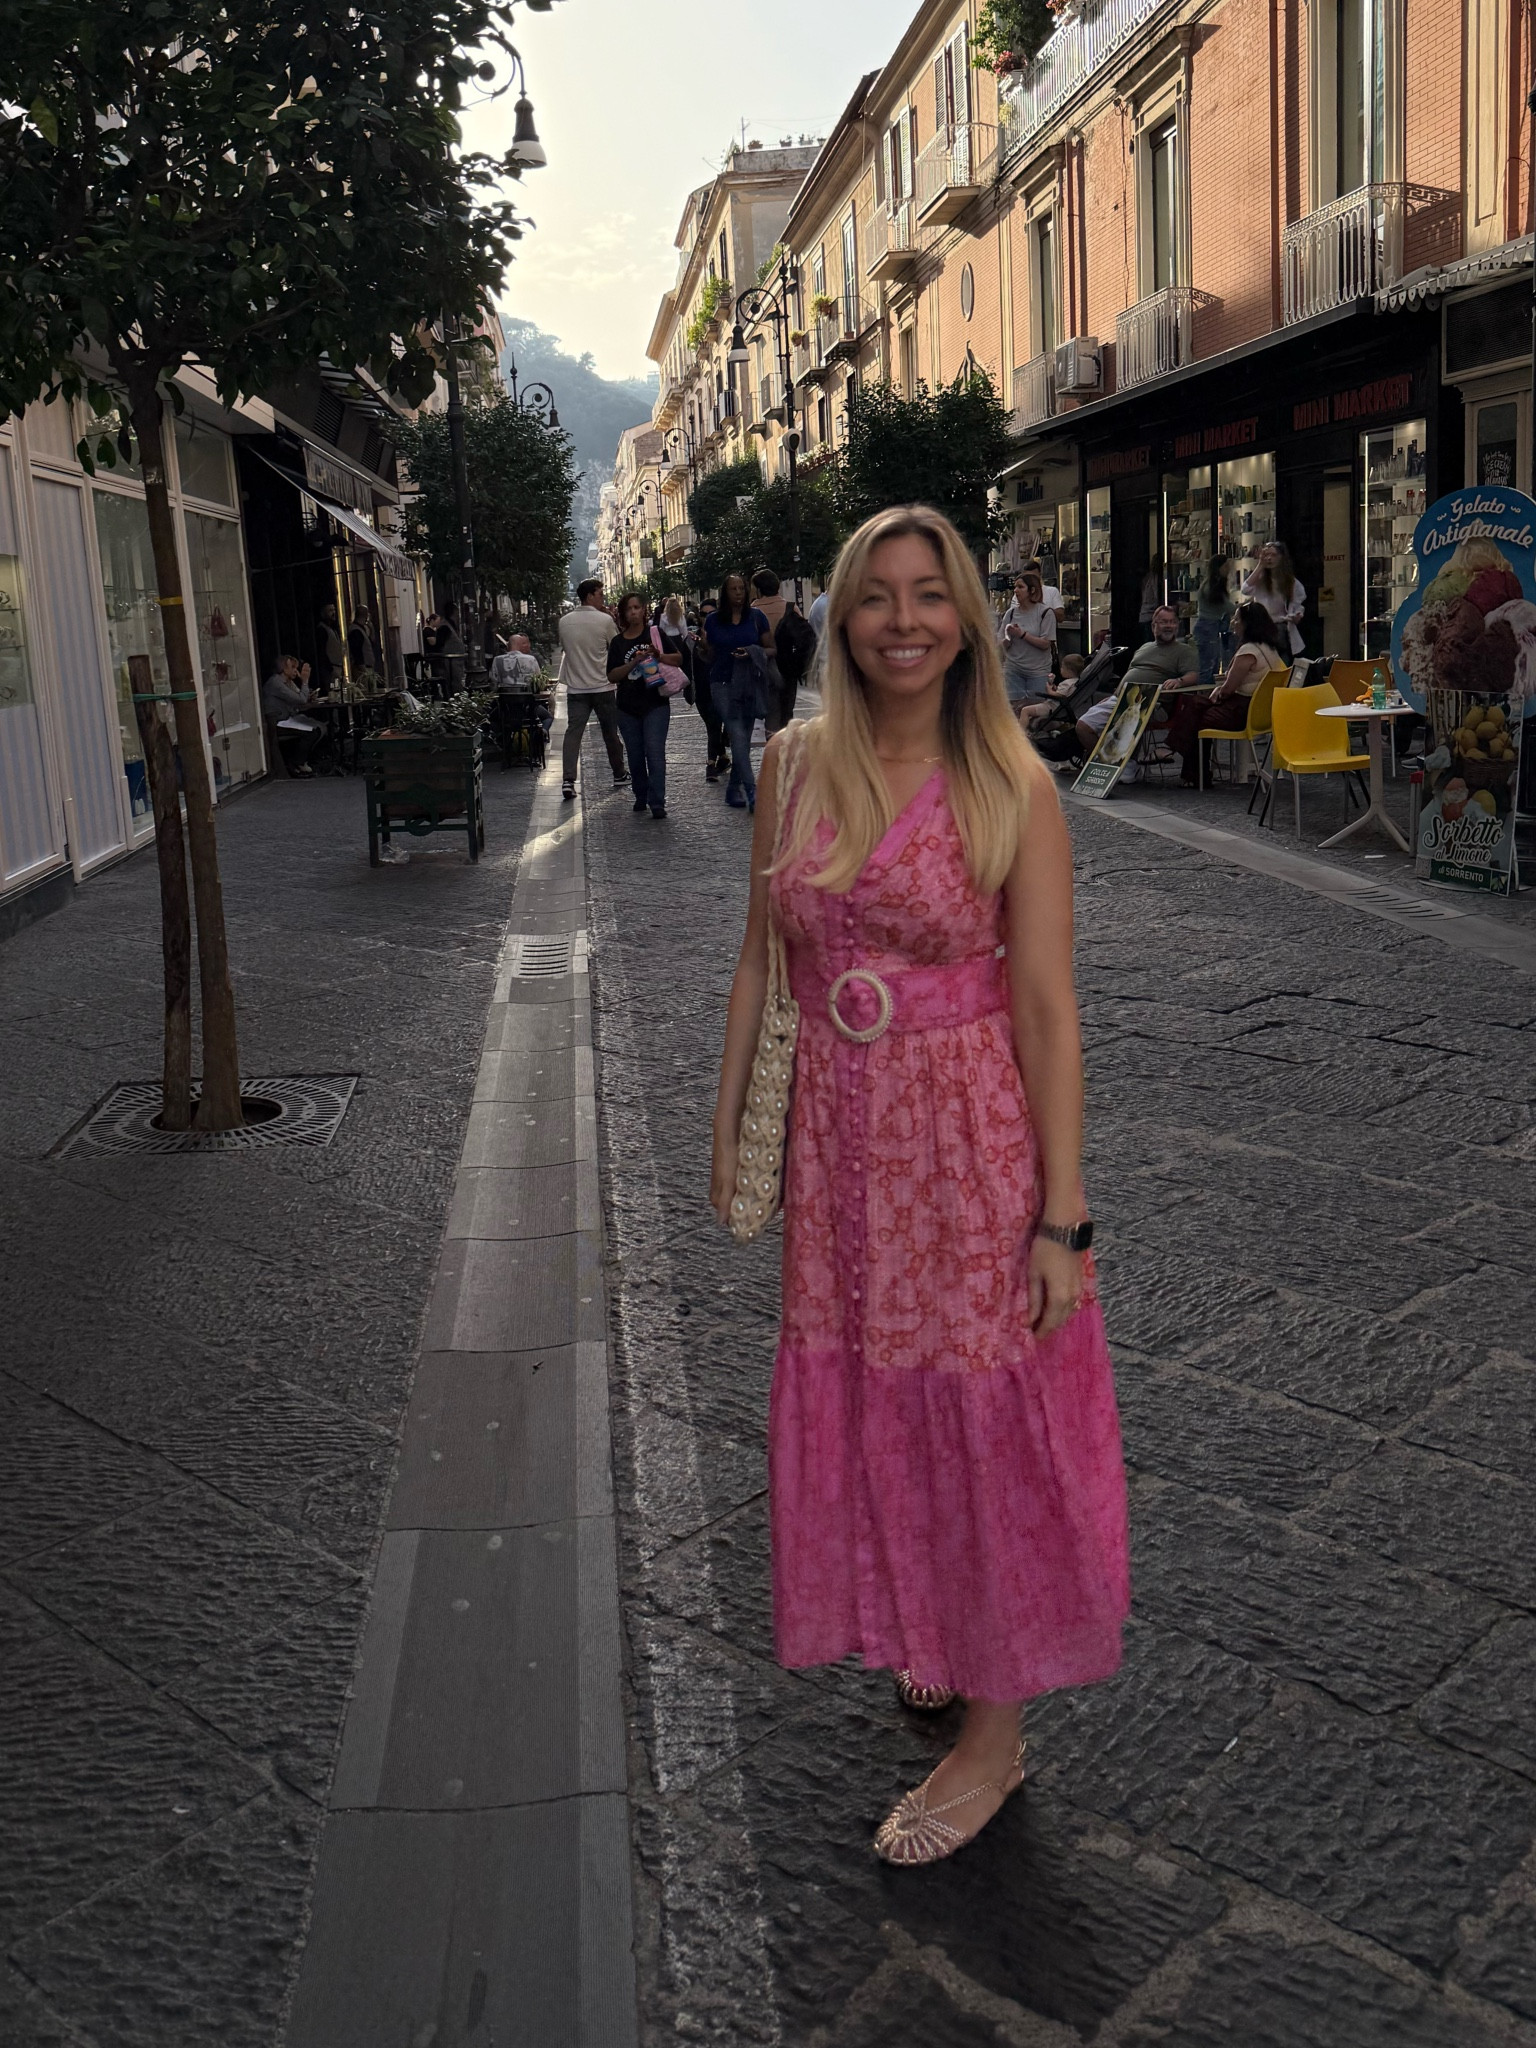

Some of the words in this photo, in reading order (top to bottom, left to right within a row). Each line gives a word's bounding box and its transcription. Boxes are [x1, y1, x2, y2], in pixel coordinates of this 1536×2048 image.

[1292, 395, 1329, 432] MINI
[1333, 373, 1413, 421] MARKET
[1174, 431, 1201, 460] MINI
[1203, 416, 1259, 452] MARKET
[1450, 494, 1506, 523] Gelato
[1422, 522, 1534, 556] Artigianale
[1424, 816, 1504, 848] Sorbetto
[1435, 847, 1446, 860] al
[1447, 844, 1491, 867] Limone
[1438, 866, 1445, 875] di
[1445, 867, 1484, 883] SORRENTO
